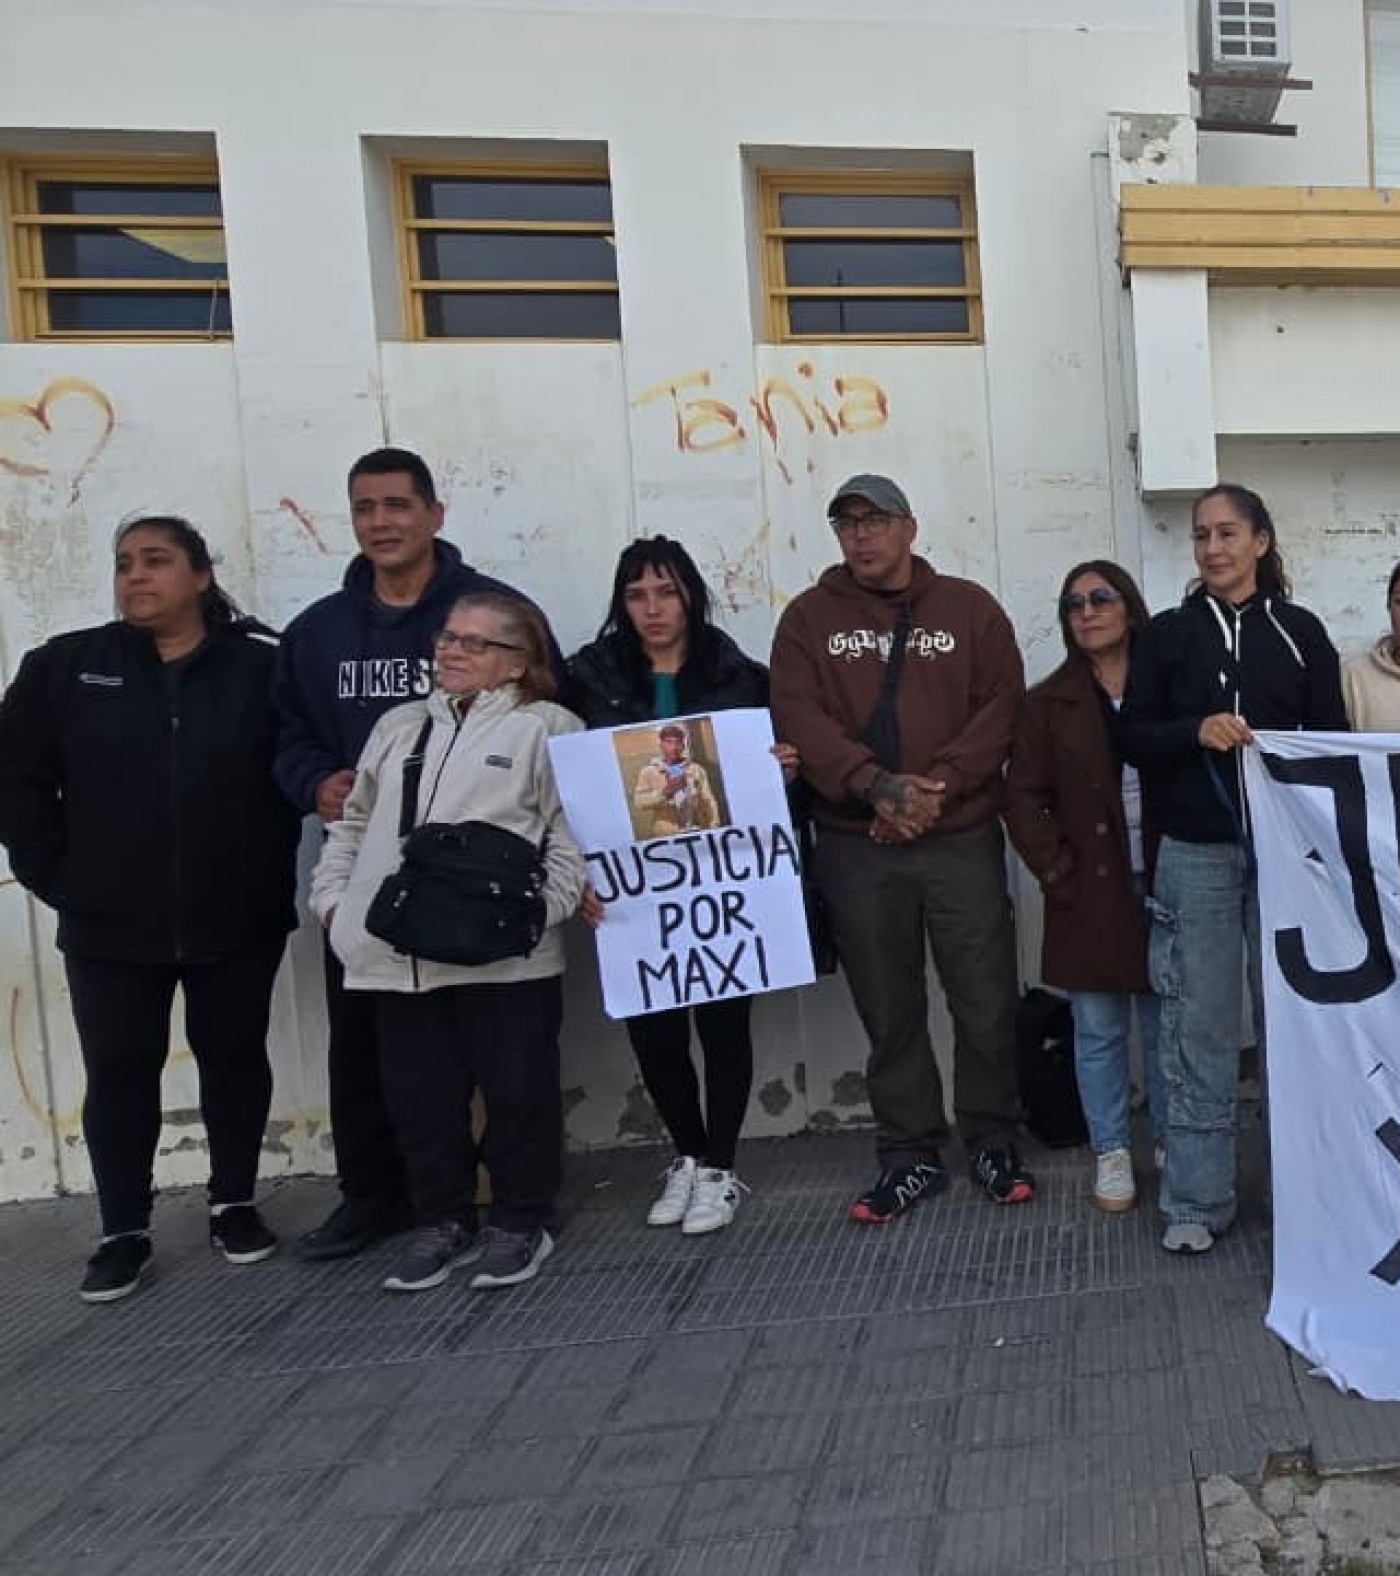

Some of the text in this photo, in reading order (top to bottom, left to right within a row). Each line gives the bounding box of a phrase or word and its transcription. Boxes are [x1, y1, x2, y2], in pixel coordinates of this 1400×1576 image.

[631, 362, 888, 454] Tania
[339, 658, 409, 698] NIKE
[584, 823, 800, 902] JUSTICIA
[658, 890, 756, 950] POR
[637, 935, 769, 1010] MAXI
